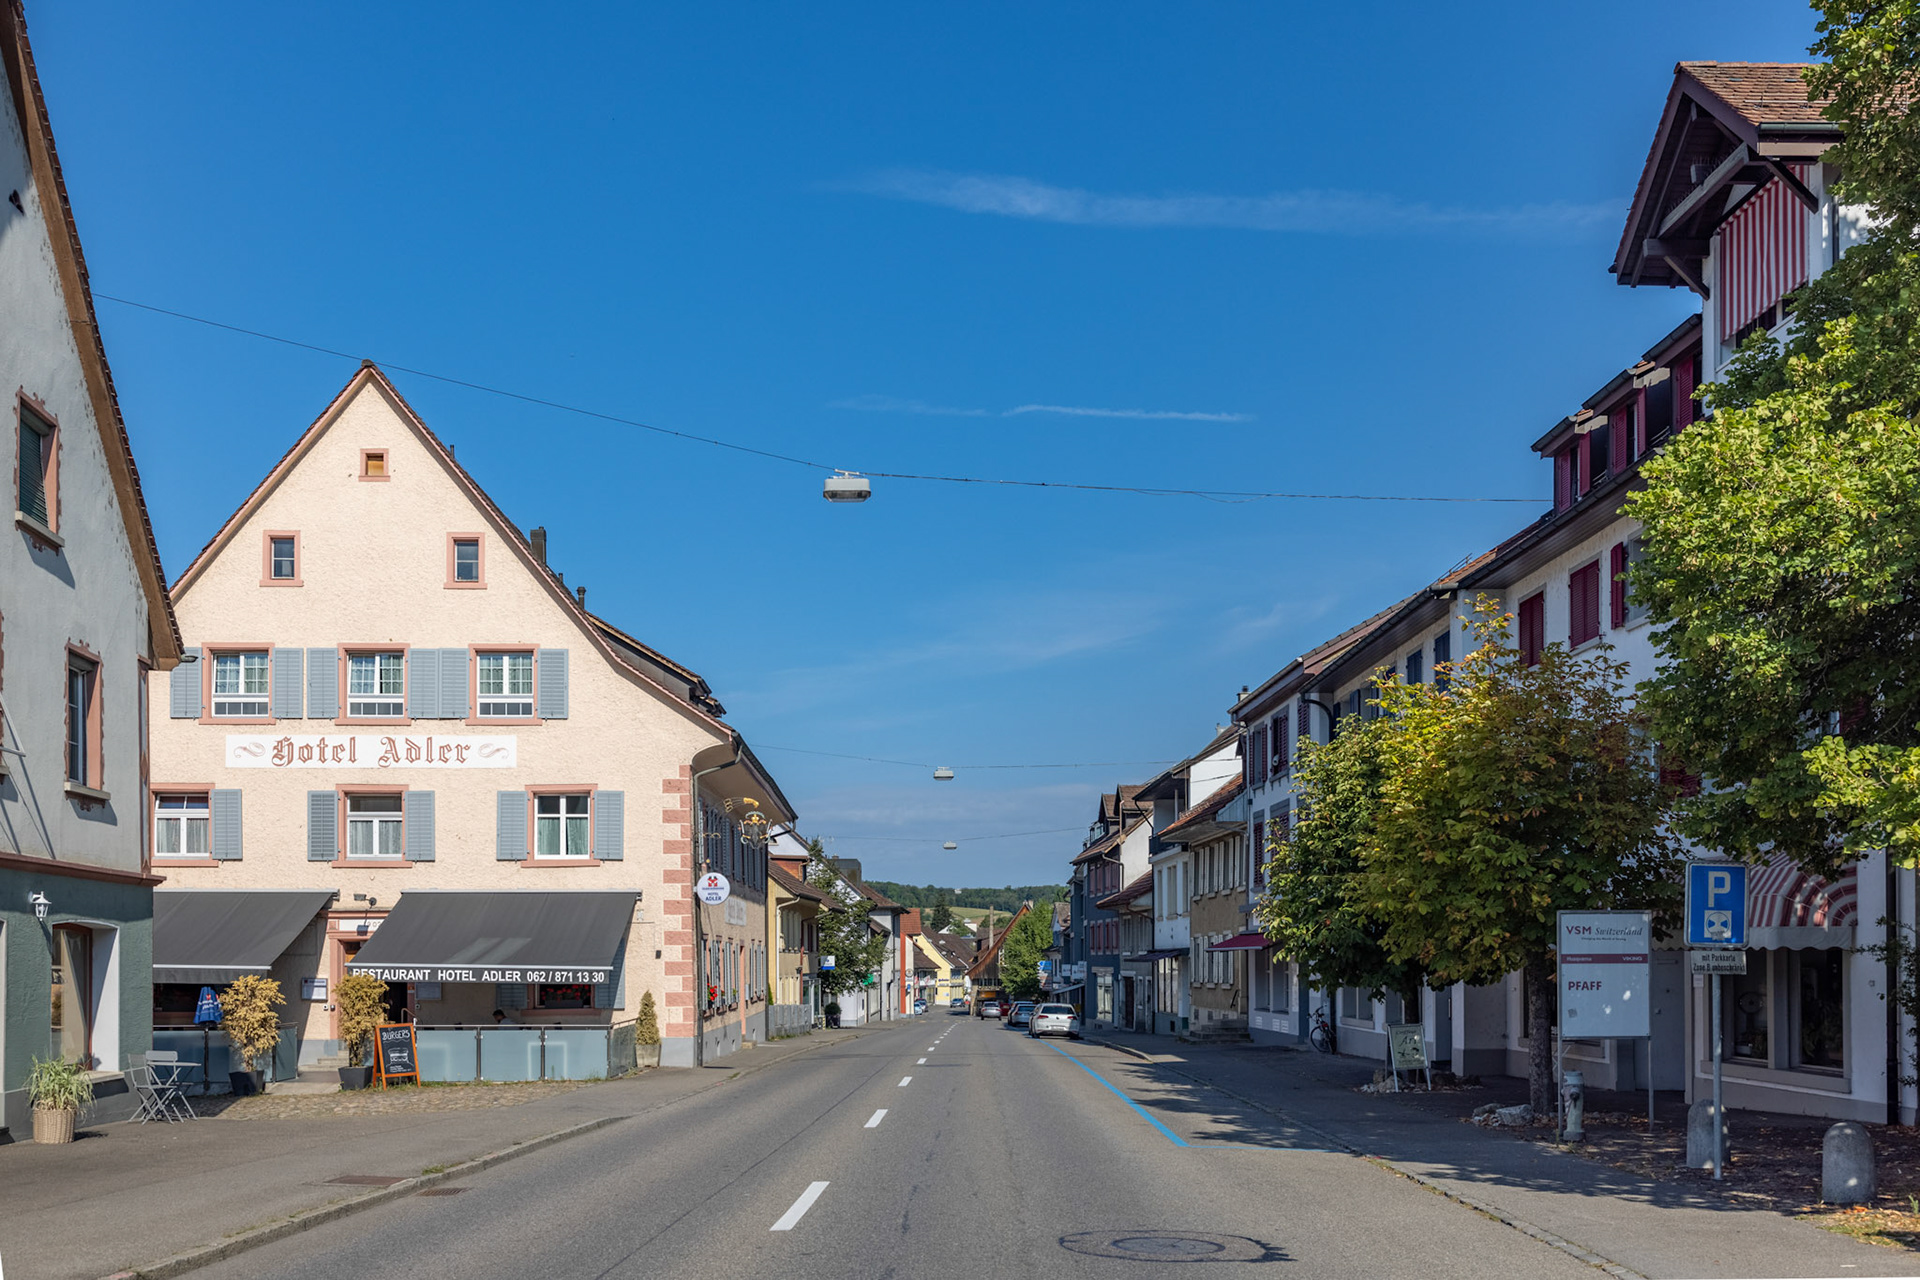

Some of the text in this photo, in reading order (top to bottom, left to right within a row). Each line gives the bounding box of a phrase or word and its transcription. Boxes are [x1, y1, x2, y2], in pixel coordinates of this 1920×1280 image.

[271, 736, 471, 768] Hotel Adler
[1708, 871, 1731, 908] P
[1566, 926, 1643, 936] VSM Switzerland
[1701, 954, 1736, 962] mit Parkkarte
[1693, 963, 1705, 972] Zone
[352, 968, 431, 981] RESTAURANT
[438, 970, 476, 981] HOTEL
[482, 970, 521, 982] ADLER
[526, 971, 546, 982] 062
[555, 971, 573, 982] 871
[576, 972, 589, 982] 13
[592, 972, 605, 983] 30
[1568, 981, 1602, 991] PFAFF
[382, 1030, 410, 1040] BURGERS
